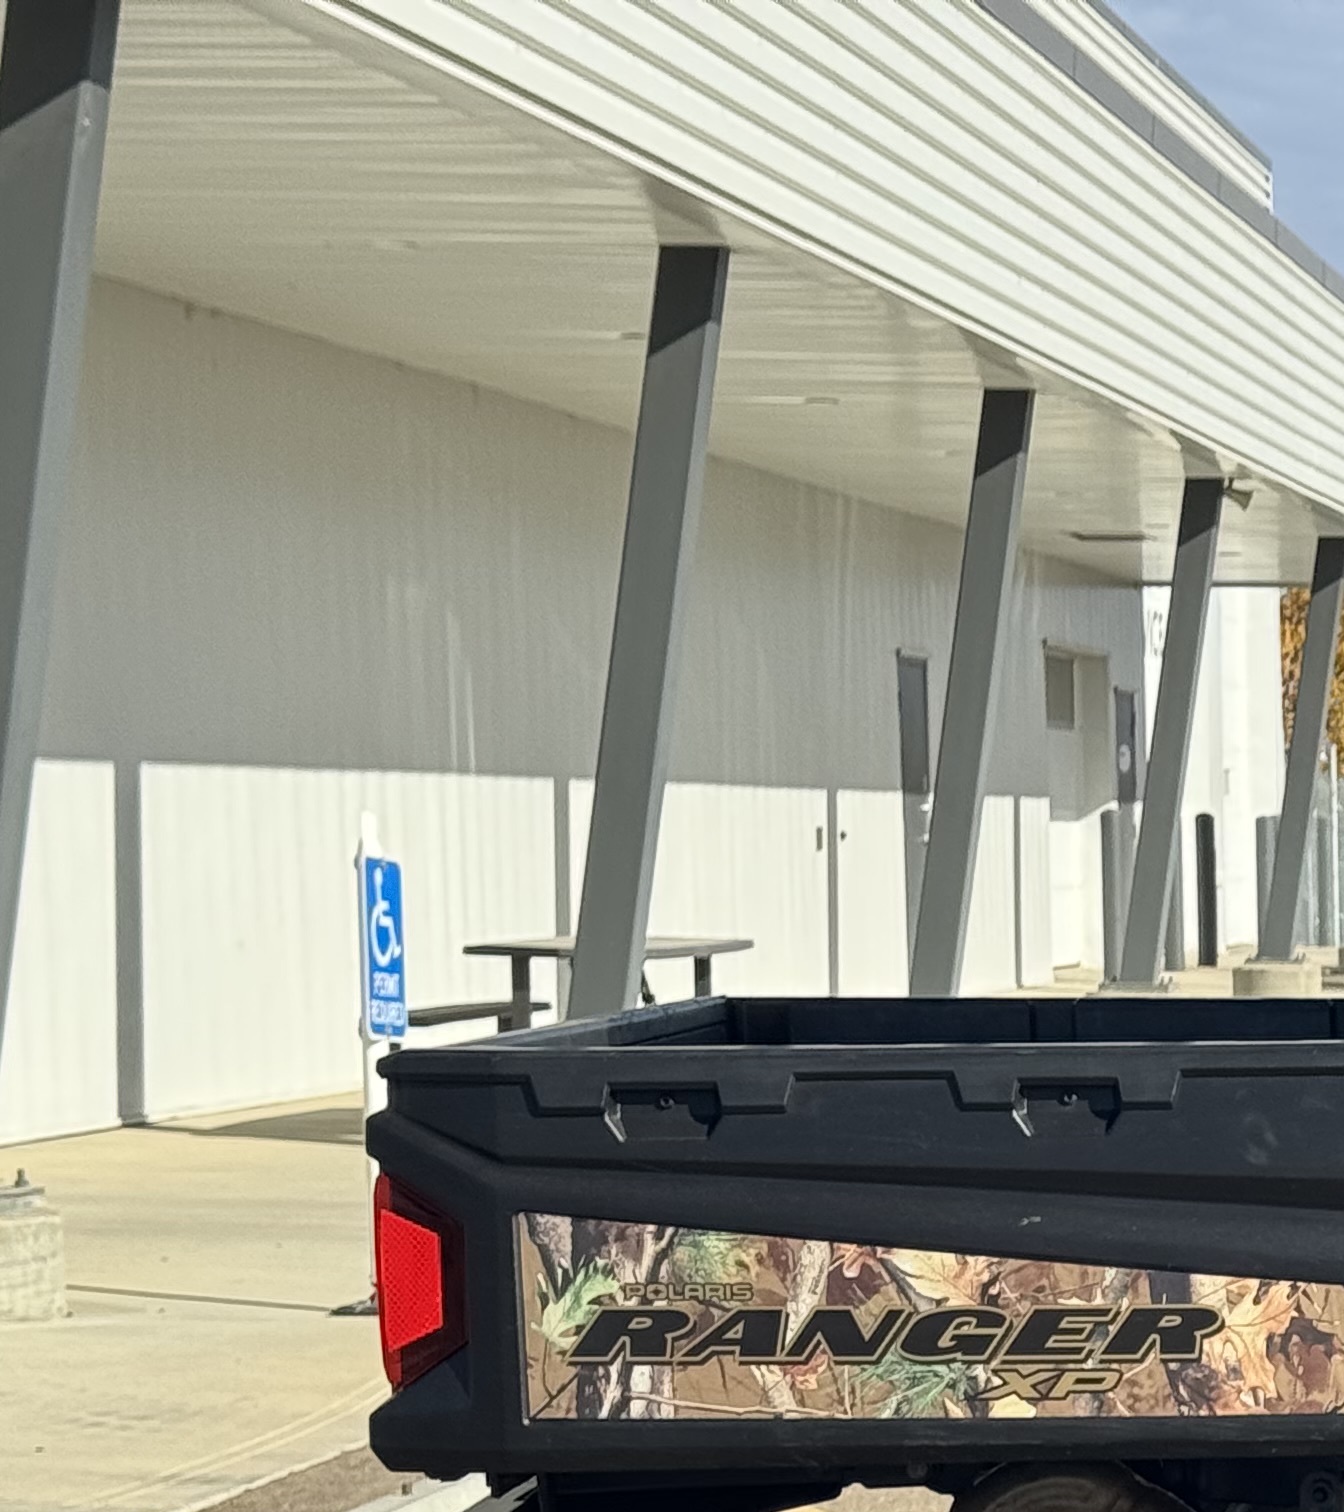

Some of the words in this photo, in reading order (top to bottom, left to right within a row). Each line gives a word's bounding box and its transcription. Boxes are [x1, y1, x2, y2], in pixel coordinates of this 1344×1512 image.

[624, 1282, 753, 1301] POLARIS
[569, 1305, 1226, 1366] RANGER
[977, 1368, 1124, 1401] XP
